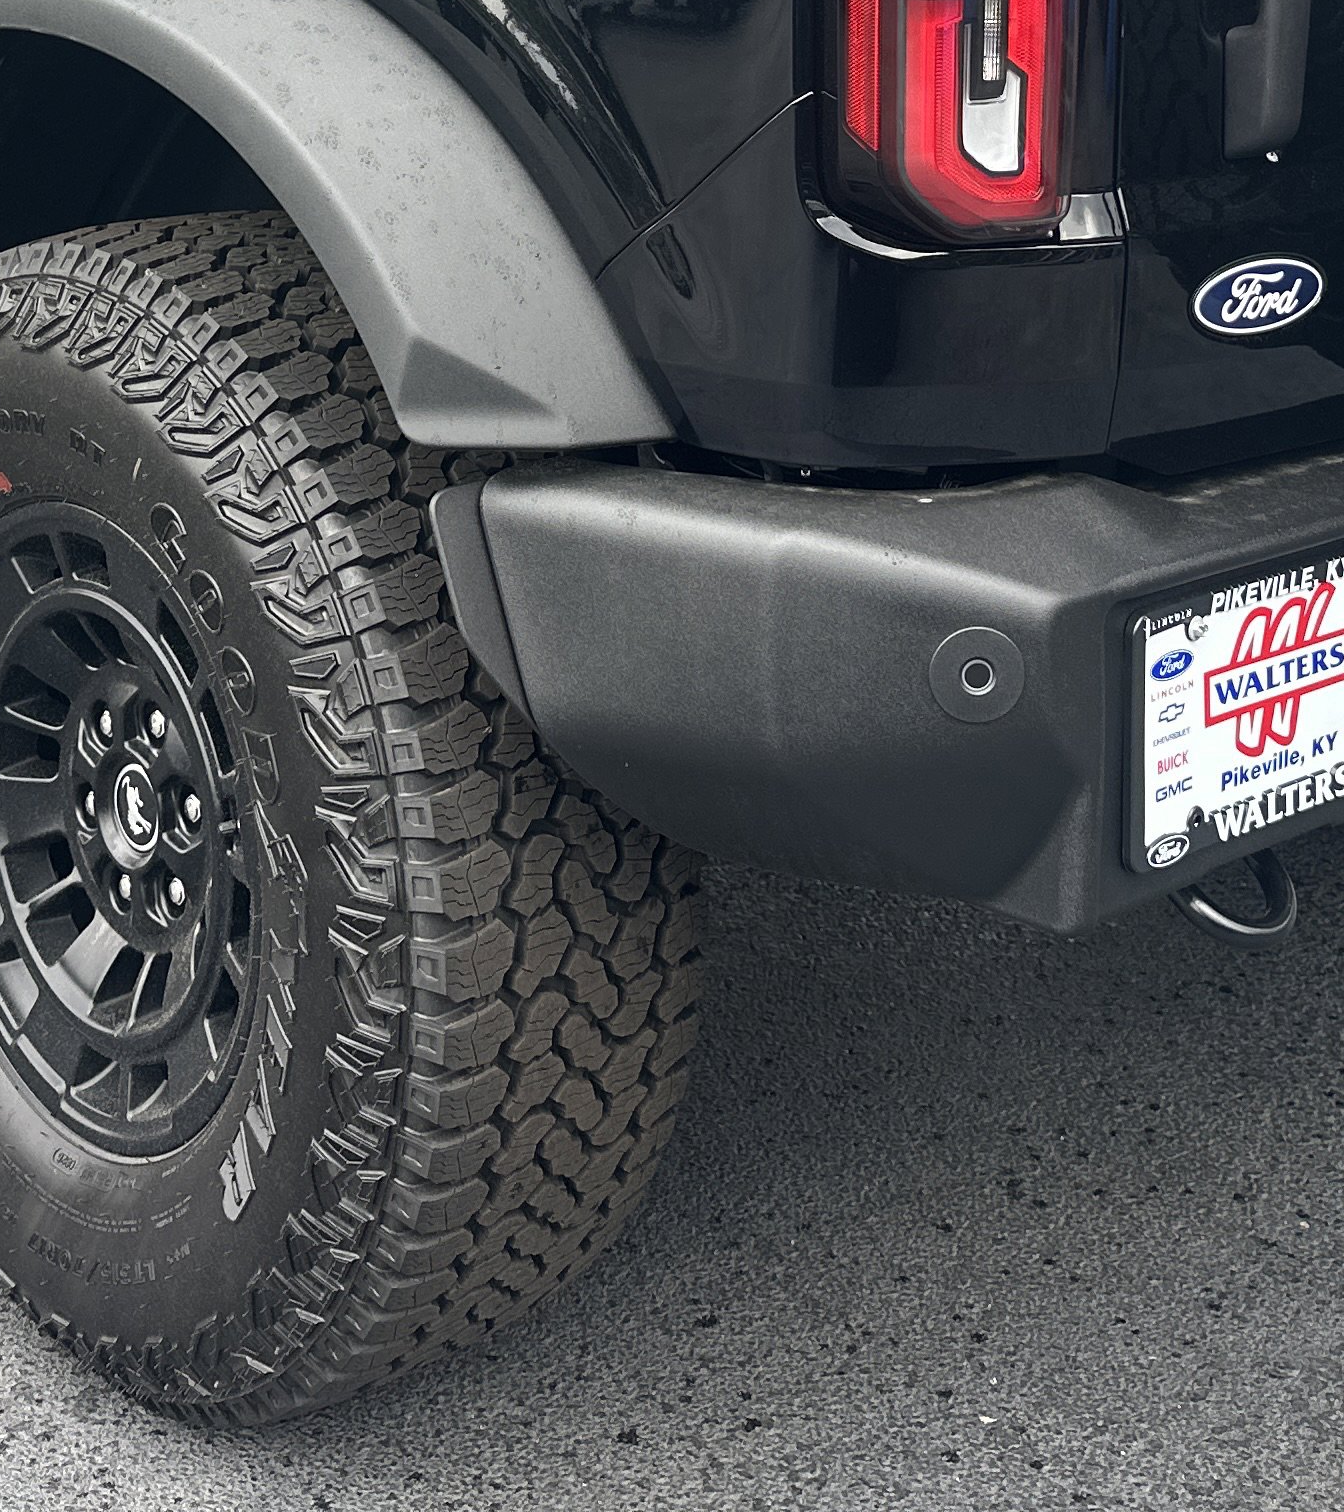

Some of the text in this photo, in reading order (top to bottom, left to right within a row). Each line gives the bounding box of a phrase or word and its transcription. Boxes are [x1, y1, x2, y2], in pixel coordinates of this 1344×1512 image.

[1221, 271, 1302, 323] Ford
[1211, 565, 1318, 615] PIKEVILLE,
[1152, 608, 1193, 631] LINCOLN
[1214, 642, 1344, 705] WALTERS
[1151, 679, 1194, 702] LINCOLN
[1153, 726, 1191, 747] CHEVROLET
[1157, 749, 1189, 775] BUICK
[1221, 731, 1338, 792] Pikeville, KY
[1156, 776, 1193, 803] GMC
